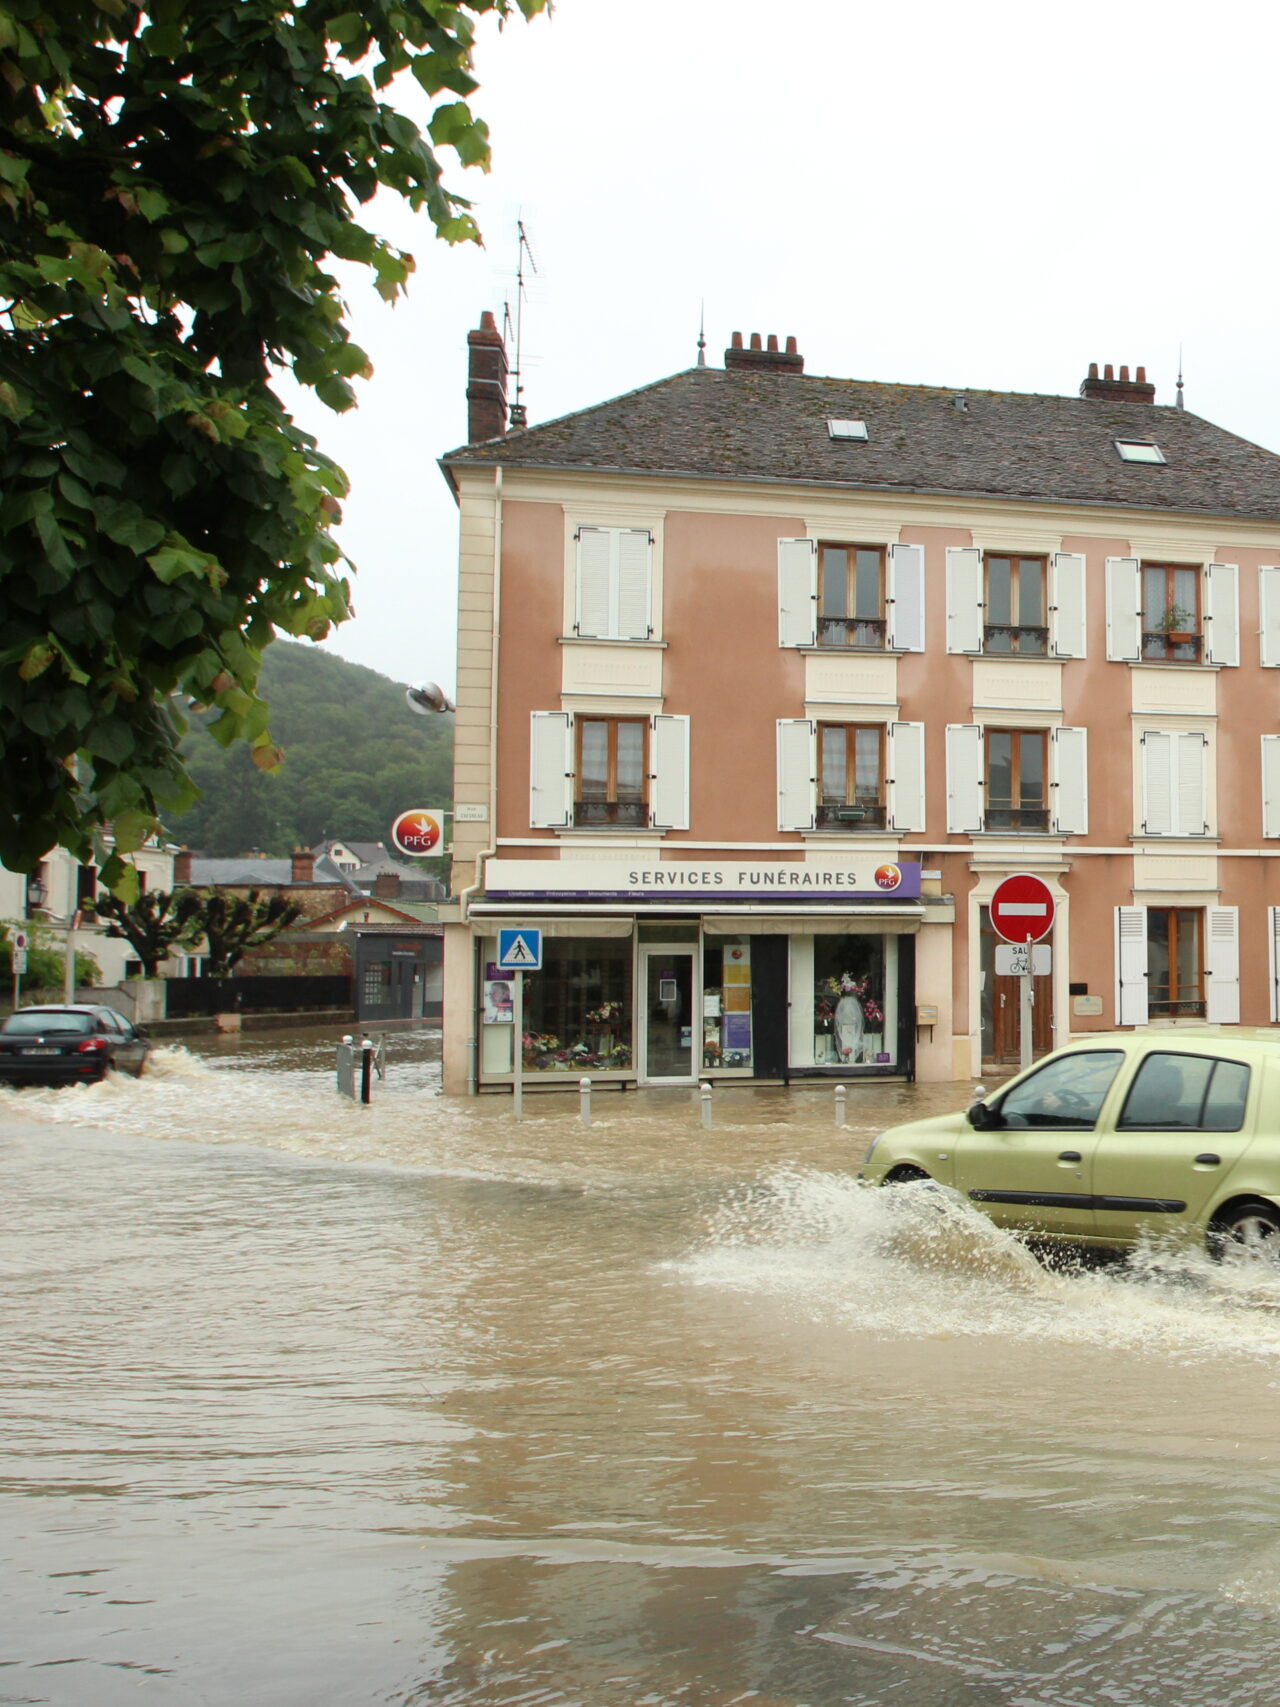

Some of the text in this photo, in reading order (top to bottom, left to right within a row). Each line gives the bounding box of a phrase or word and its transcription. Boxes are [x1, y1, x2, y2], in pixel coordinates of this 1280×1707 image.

[404, 835, 431, 846] PFG
[628, 869, 858, 885] SERVICES FUNÉRAIRES
[878, 878, 895, 886] PFG
